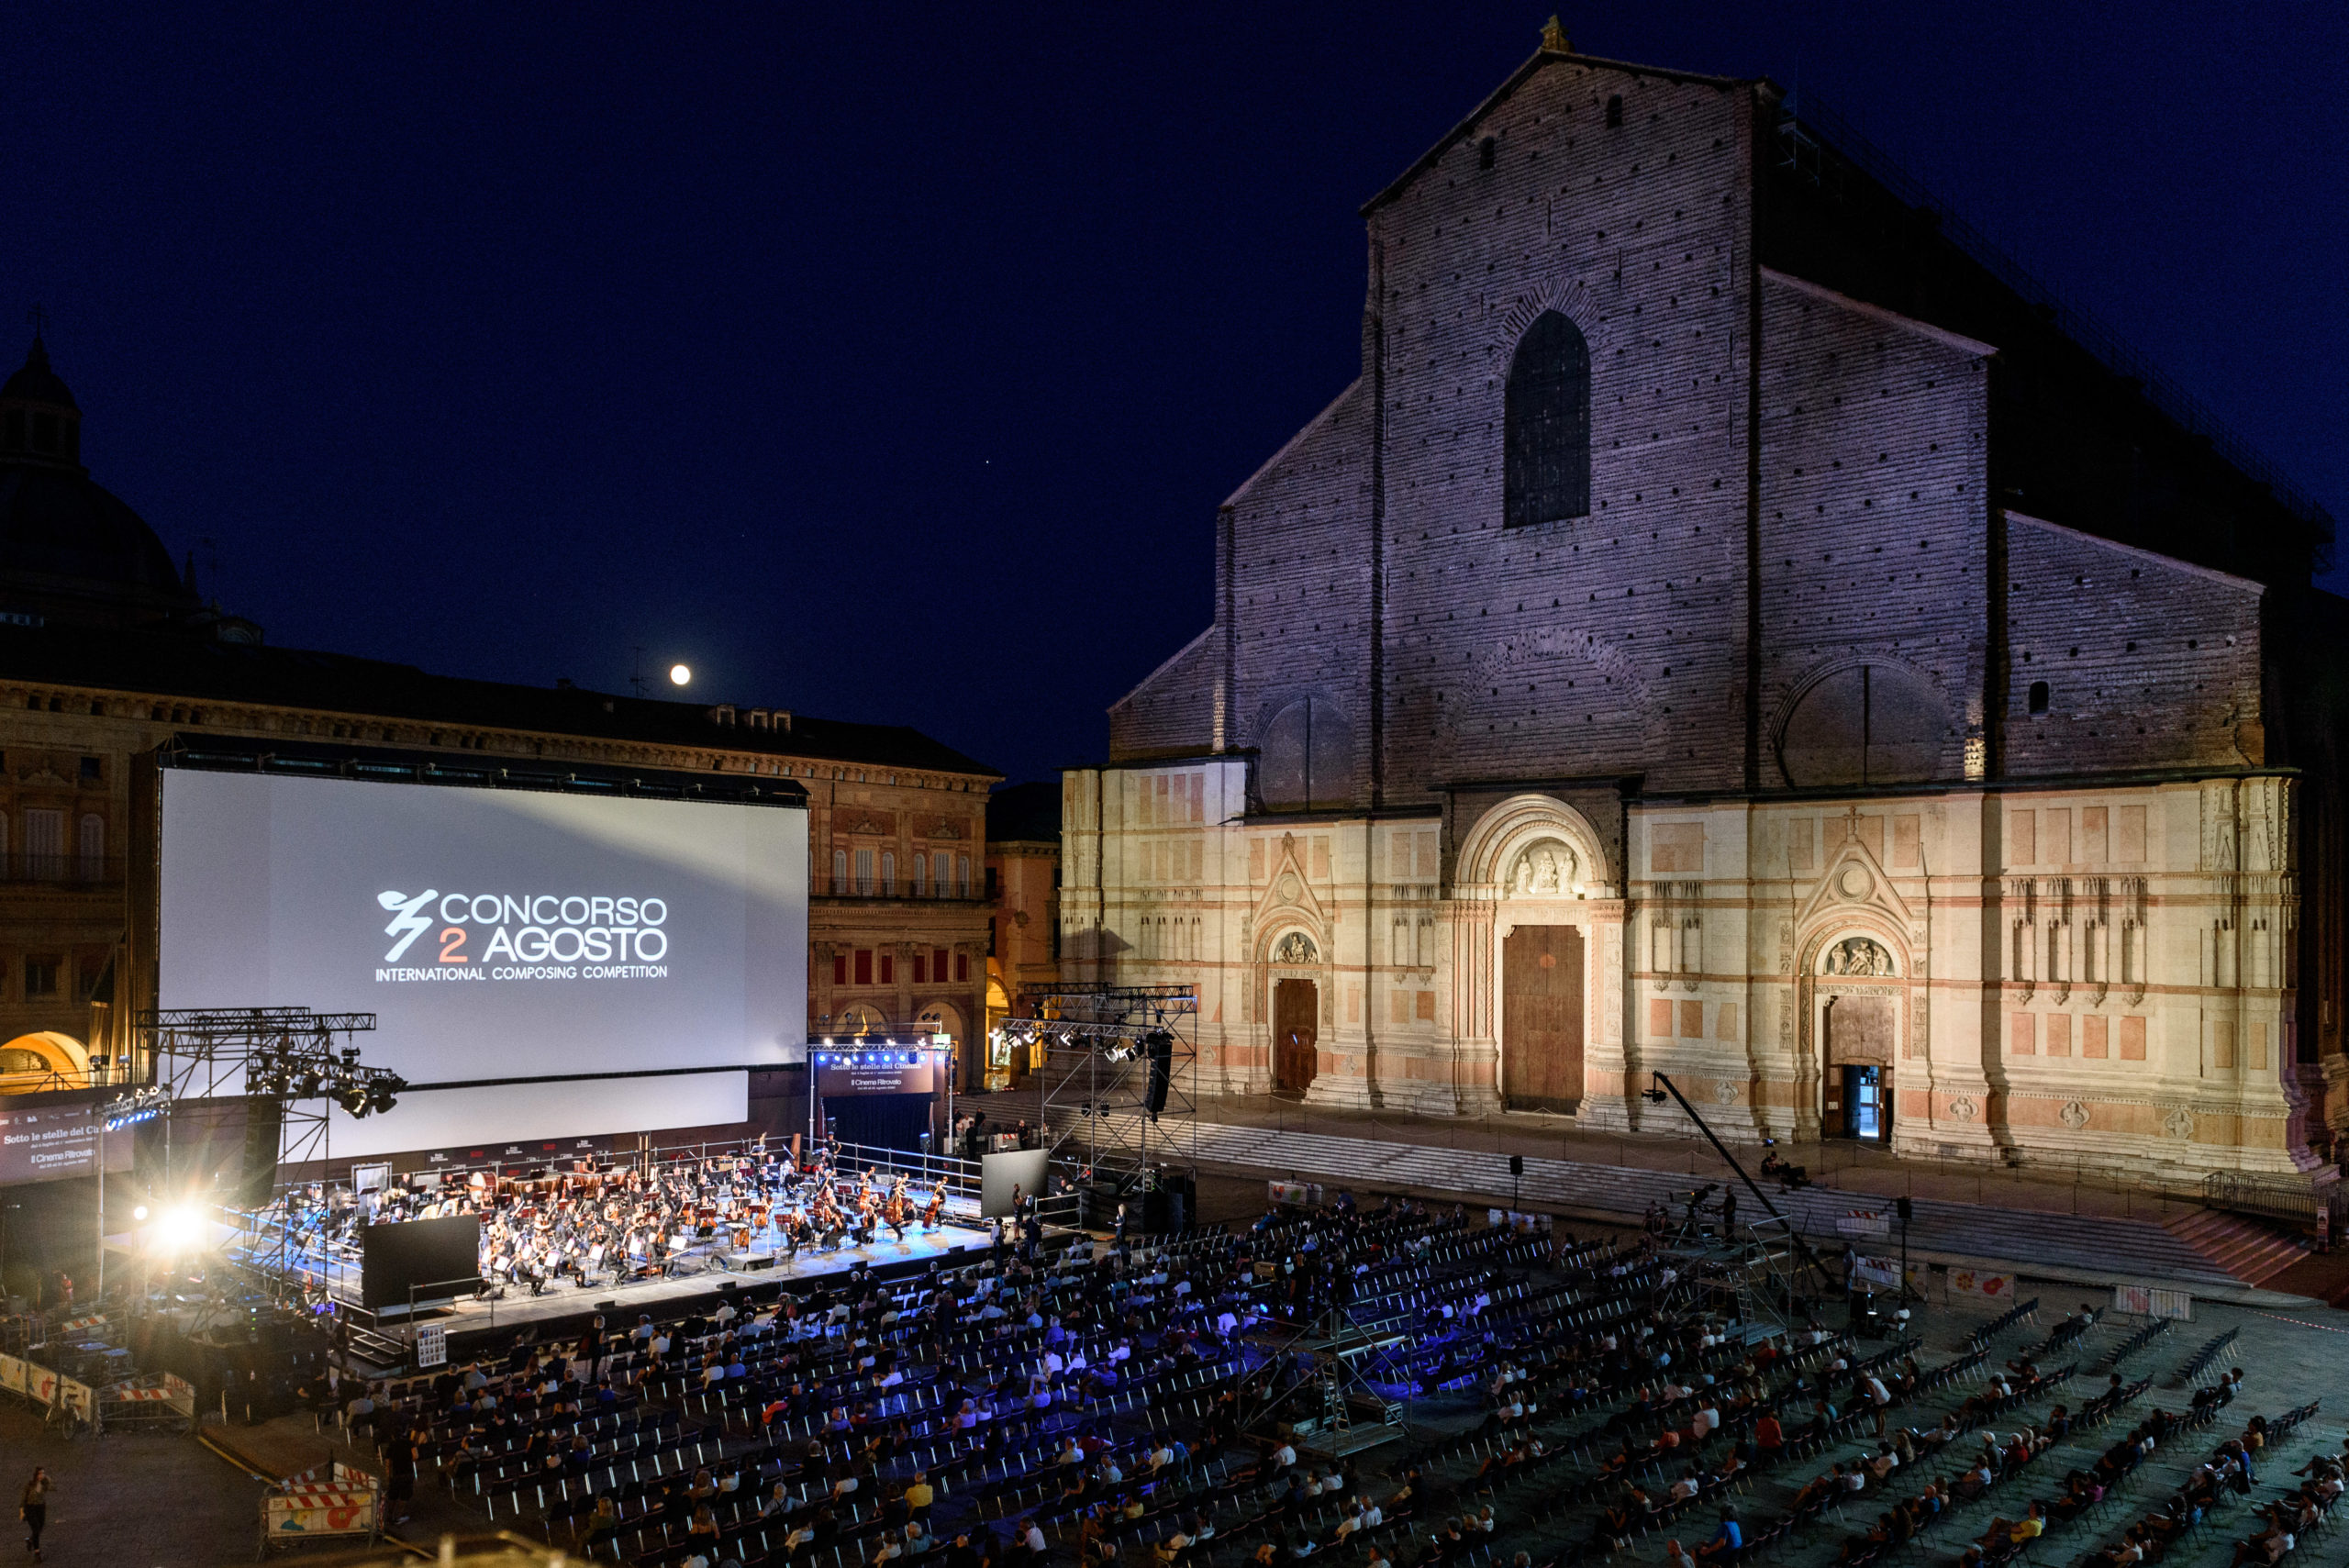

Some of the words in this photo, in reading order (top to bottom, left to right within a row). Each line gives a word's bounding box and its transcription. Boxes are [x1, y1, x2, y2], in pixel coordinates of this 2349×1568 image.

[440, 893, 668, 927] CONCORSO
[439, 927, 469, 963] 2
[481, 926, 668, 962] AGOSTO
[375, 967, 486, 982] INTERNATIONAL
[491, 965, 578, 981] COMPOSING
[582, 964, 668, 979] COMPETITION
[4, 1135, 29, 1145] Sotto
[31, 1131, 40, 1141] le
[41, 1129, 69, 1140] stelle
[70, 1126, 84, 1137] del
[36, 1151, 64, 1163] Cinema
[64, 1148, 95, 1160] Ritrovato
